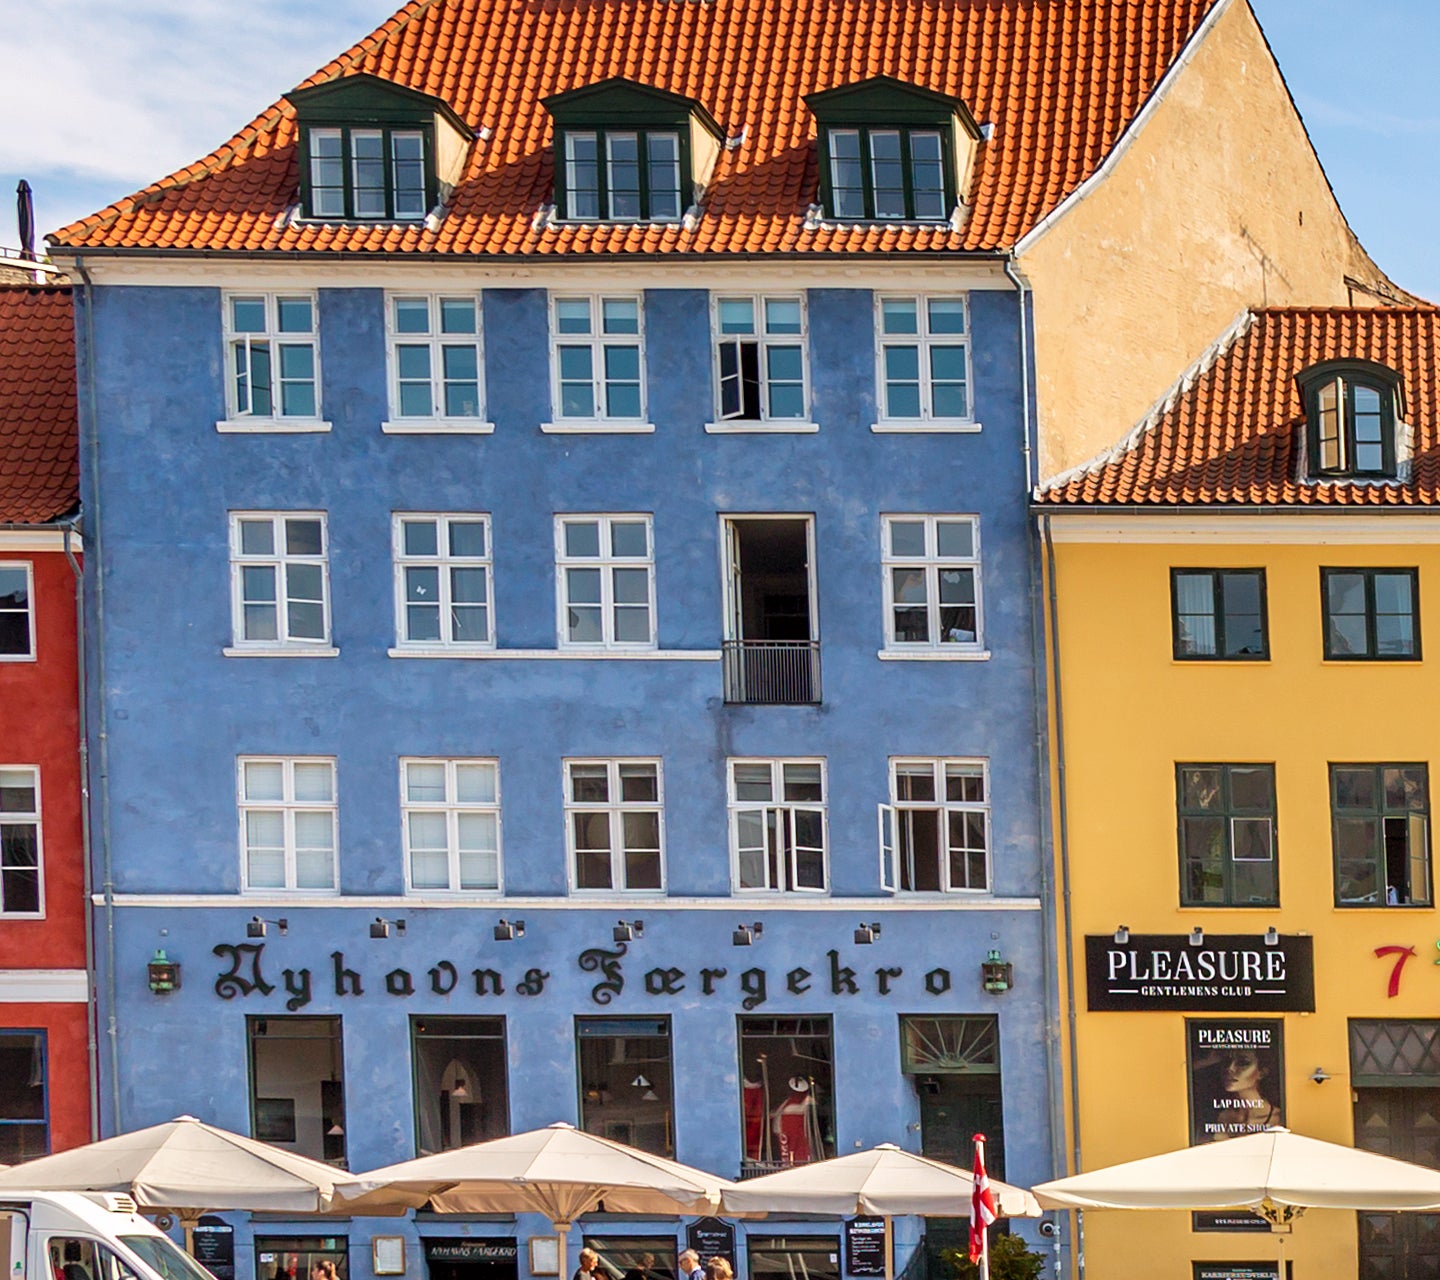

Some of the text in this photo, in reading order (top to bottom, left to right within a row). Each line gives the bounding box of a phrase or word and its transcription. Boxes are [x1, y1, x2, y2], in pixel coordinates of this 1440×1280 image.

[1107, 950, 1286, 981] PLEASURE
[1374, 944, 1417, 999] 7
[1141, 986, 1252, 997] GENTLEMENS CLUB
[1198, 1029, 1271, 1043] PLEASURE
[1213, 1098, 1265, 1109] LAP DANCE
[1205, 1123, 1246, 1133] PRIVATE
